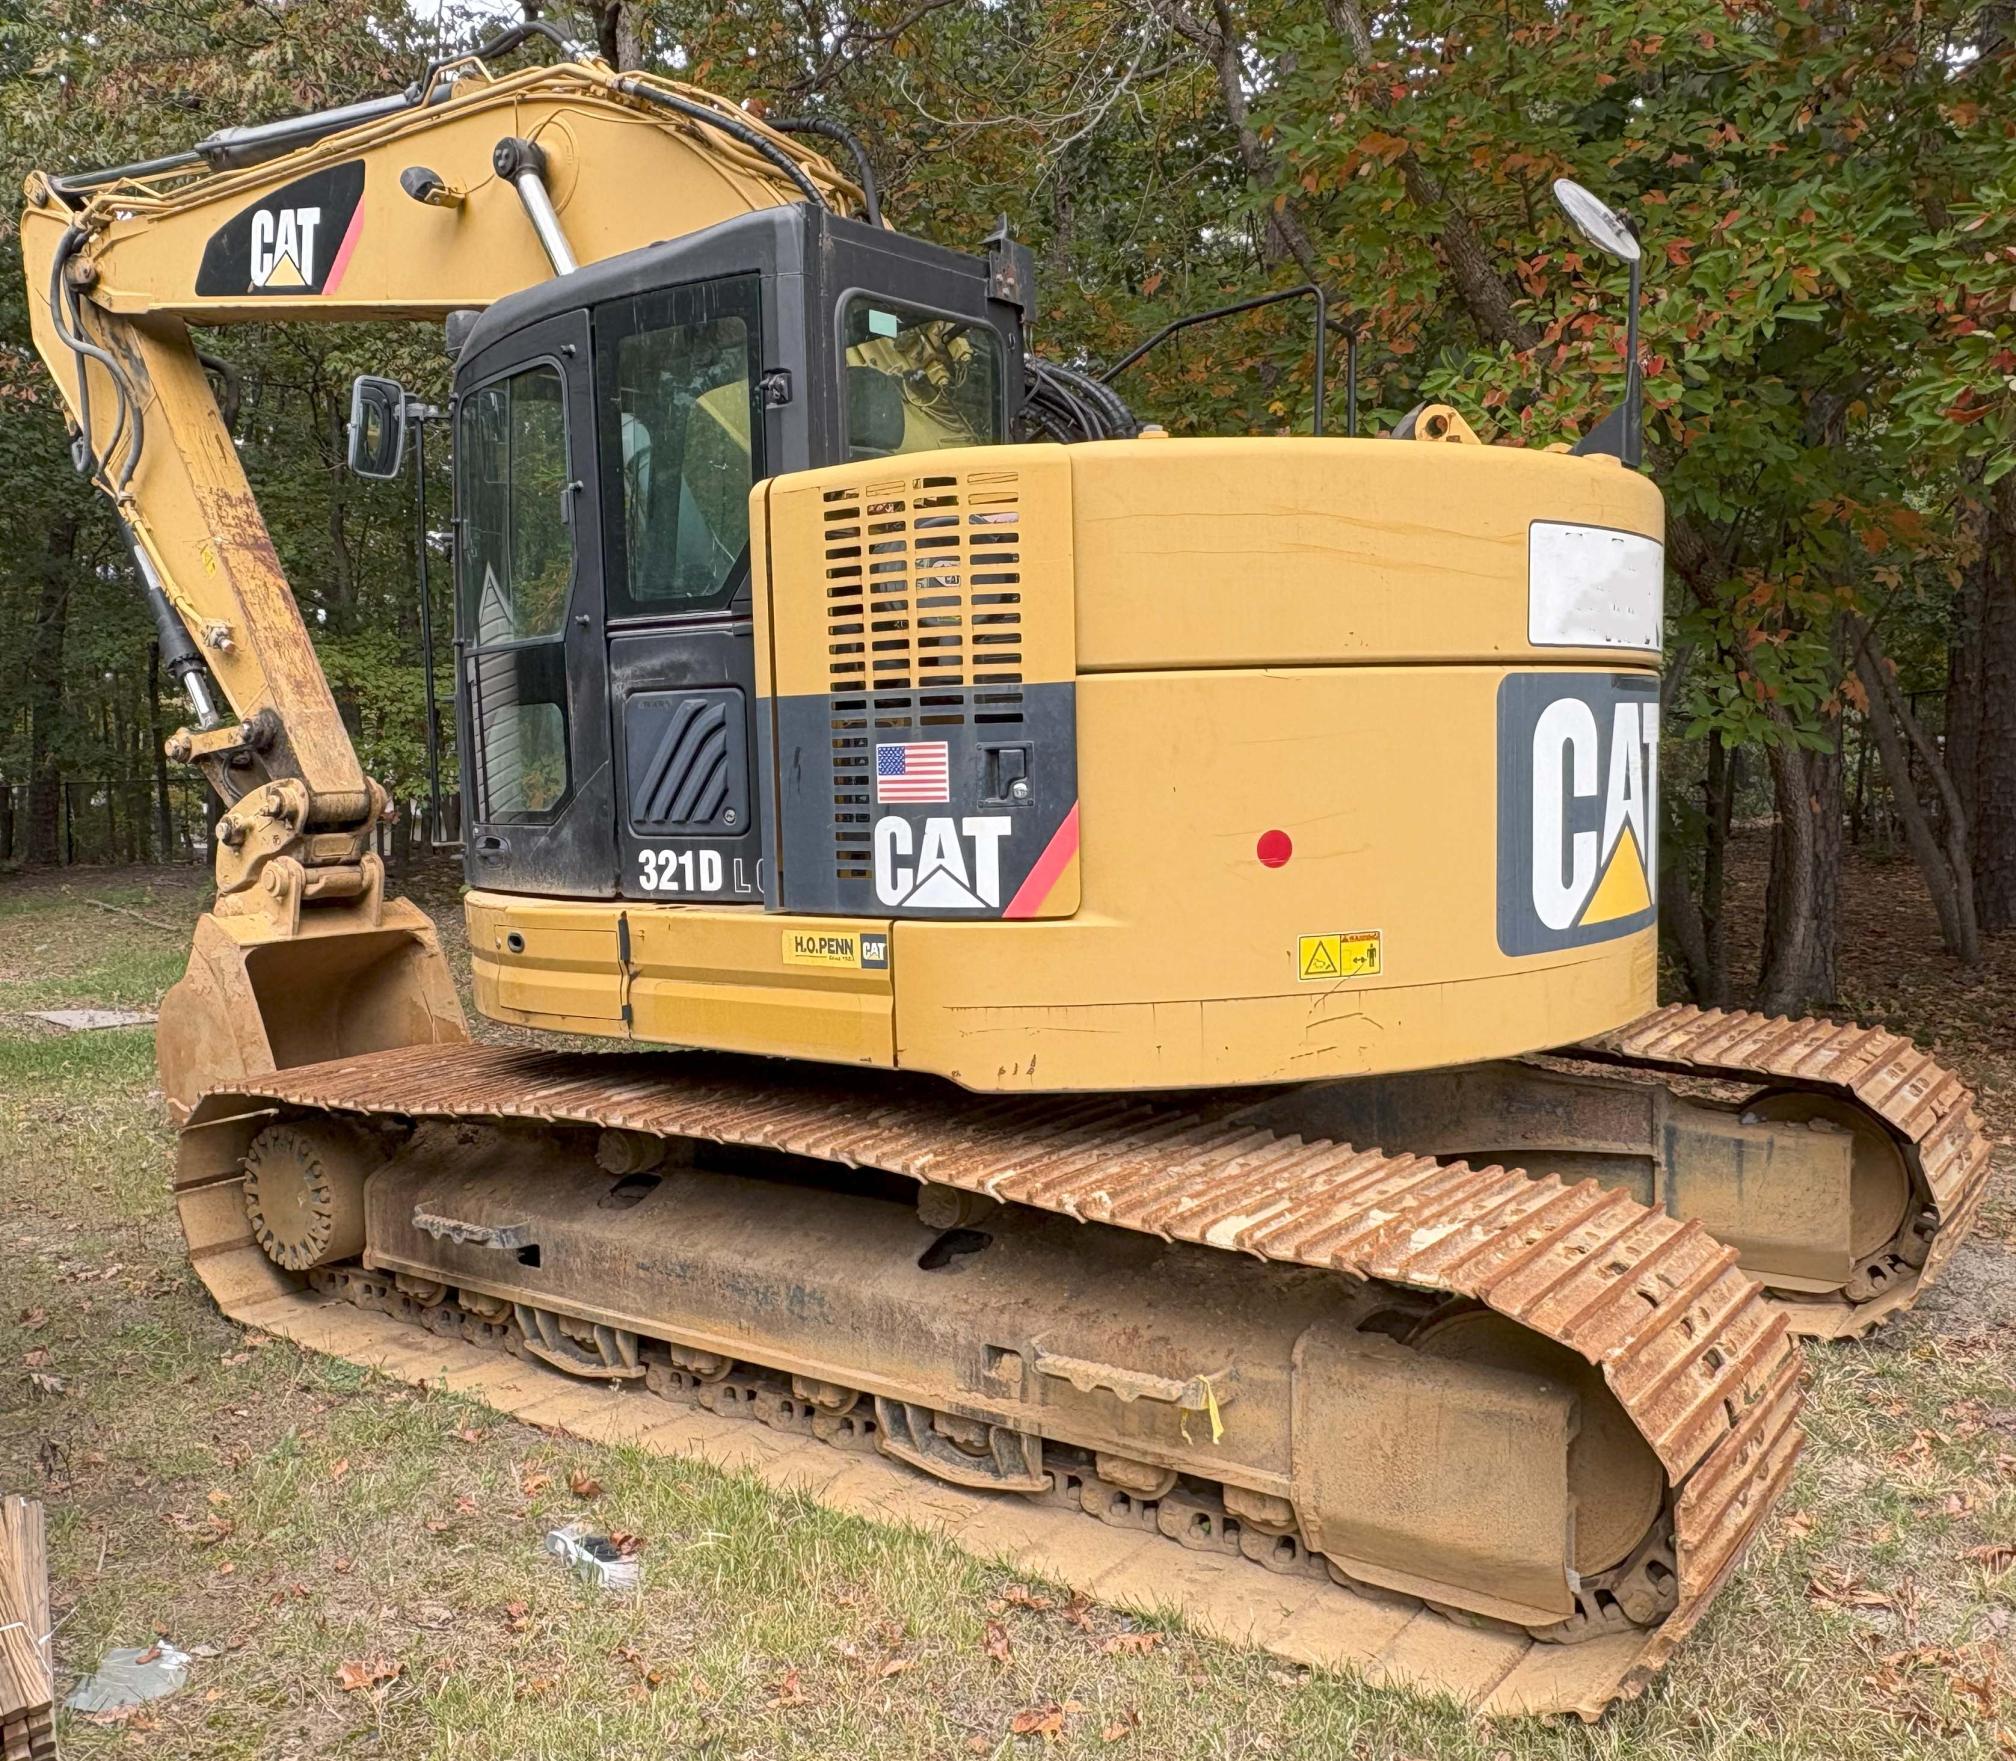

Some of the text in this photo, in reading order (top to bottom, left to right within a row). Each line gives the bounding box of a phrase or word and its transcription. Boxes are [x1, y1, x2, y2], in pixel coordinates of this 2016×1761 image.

[251, 207, 321, 287] CAT
[1532, 697, 1659, 931] CAT
[638, 849, 723, 891] 321D
[874, 815, 1012, 908] CAT
[862, 941, 887, 961] CAT
